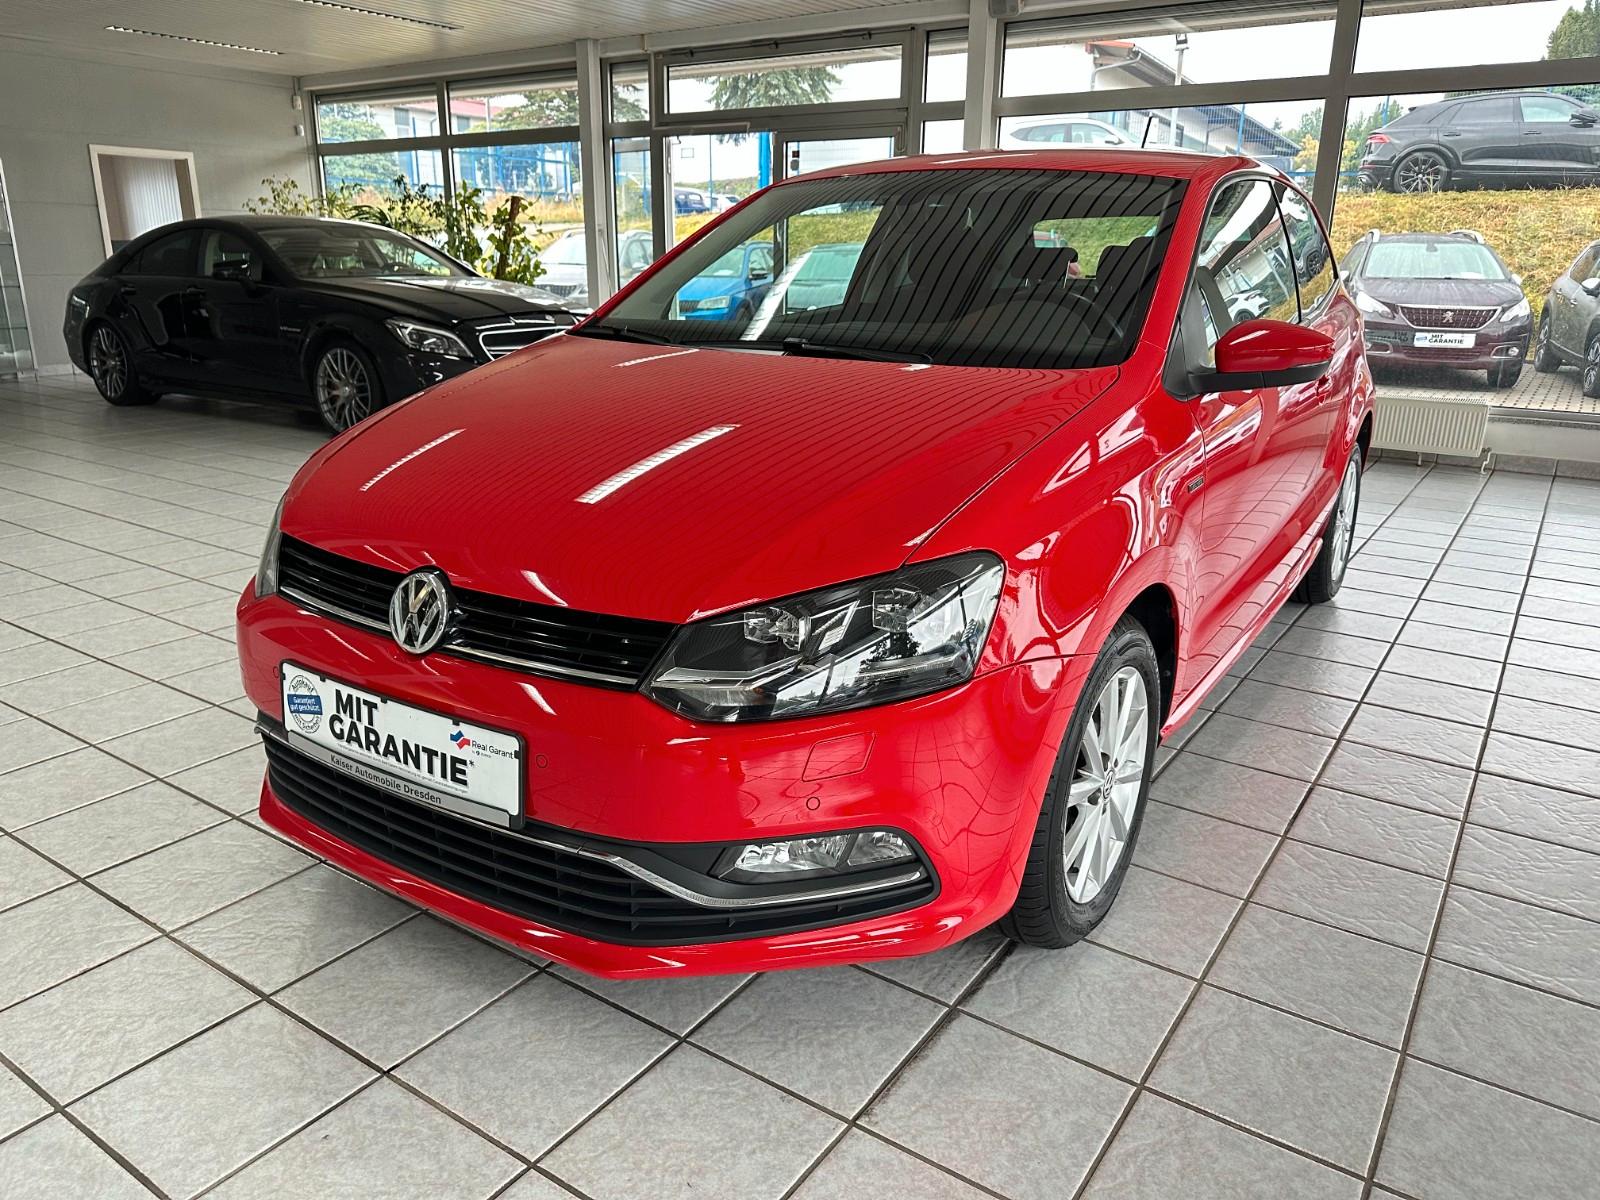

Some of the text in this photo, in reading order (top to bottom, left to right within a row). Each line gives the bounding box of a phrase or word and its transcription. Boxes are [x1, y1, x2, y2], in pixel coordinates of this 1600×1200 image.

[335, 689, 378, 727] MIT
[471, 740, 488, 751] Real
[488, 745, 514, 760] Garant
[330, 754, 353, 771] Kaiser
[355, 766, 402, 790] Automobile
[403, 784, 442, 805] Dresden
